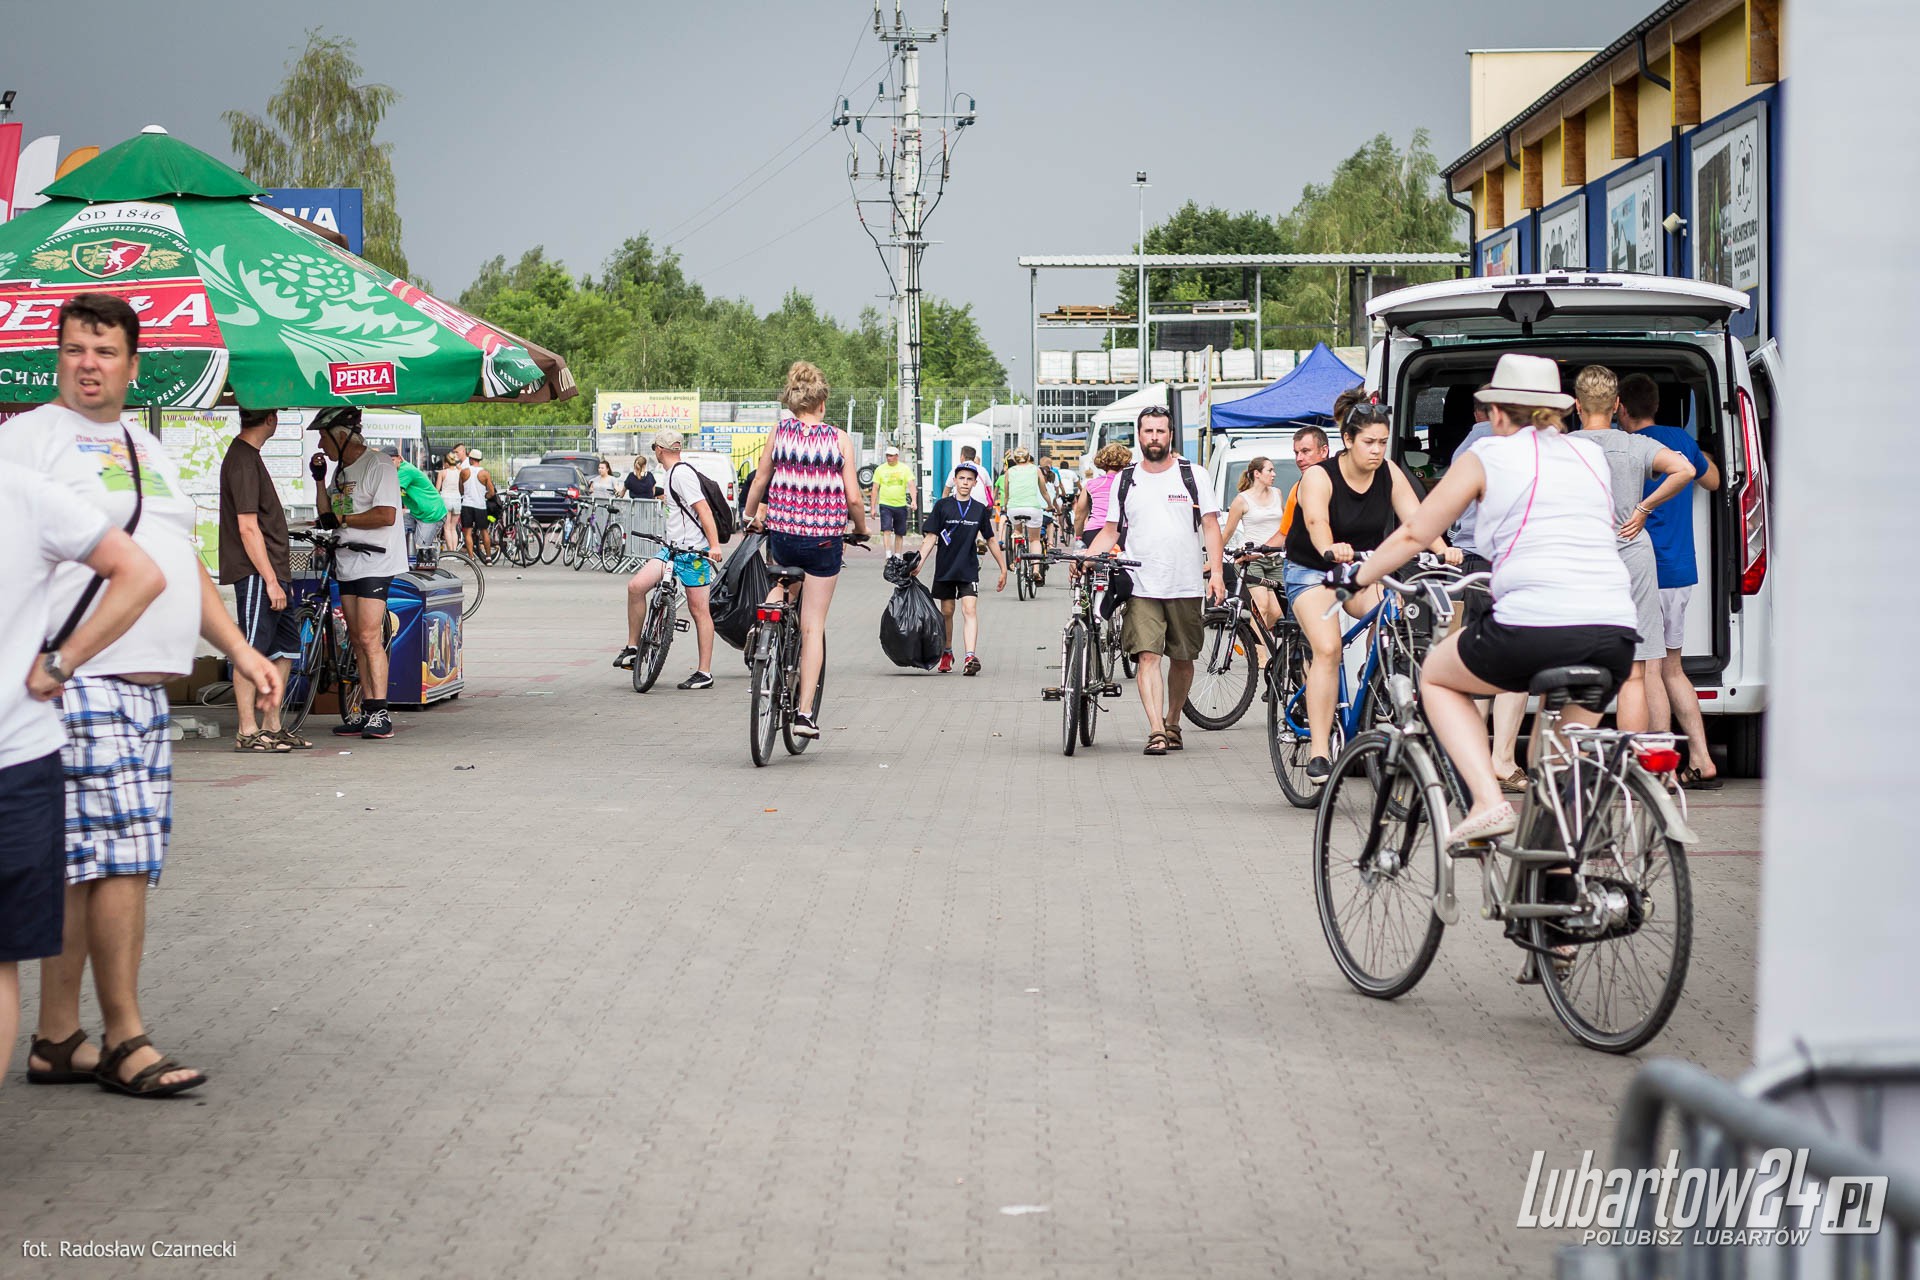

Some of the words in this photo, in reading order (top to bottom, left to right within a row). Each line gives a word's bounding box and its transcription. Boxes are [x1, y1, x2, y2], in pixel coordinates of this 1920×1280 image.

[78, 210, 107, 222] OD
[116, 208, 162, 222] 1846
[83, 224, 136, 235] NAJWYŻSZA
[335, 367, 391, 388] PERŁA
[156, 379, 188, 405] PEŁNE
[622, 404, 689, 417] REKLAMY
